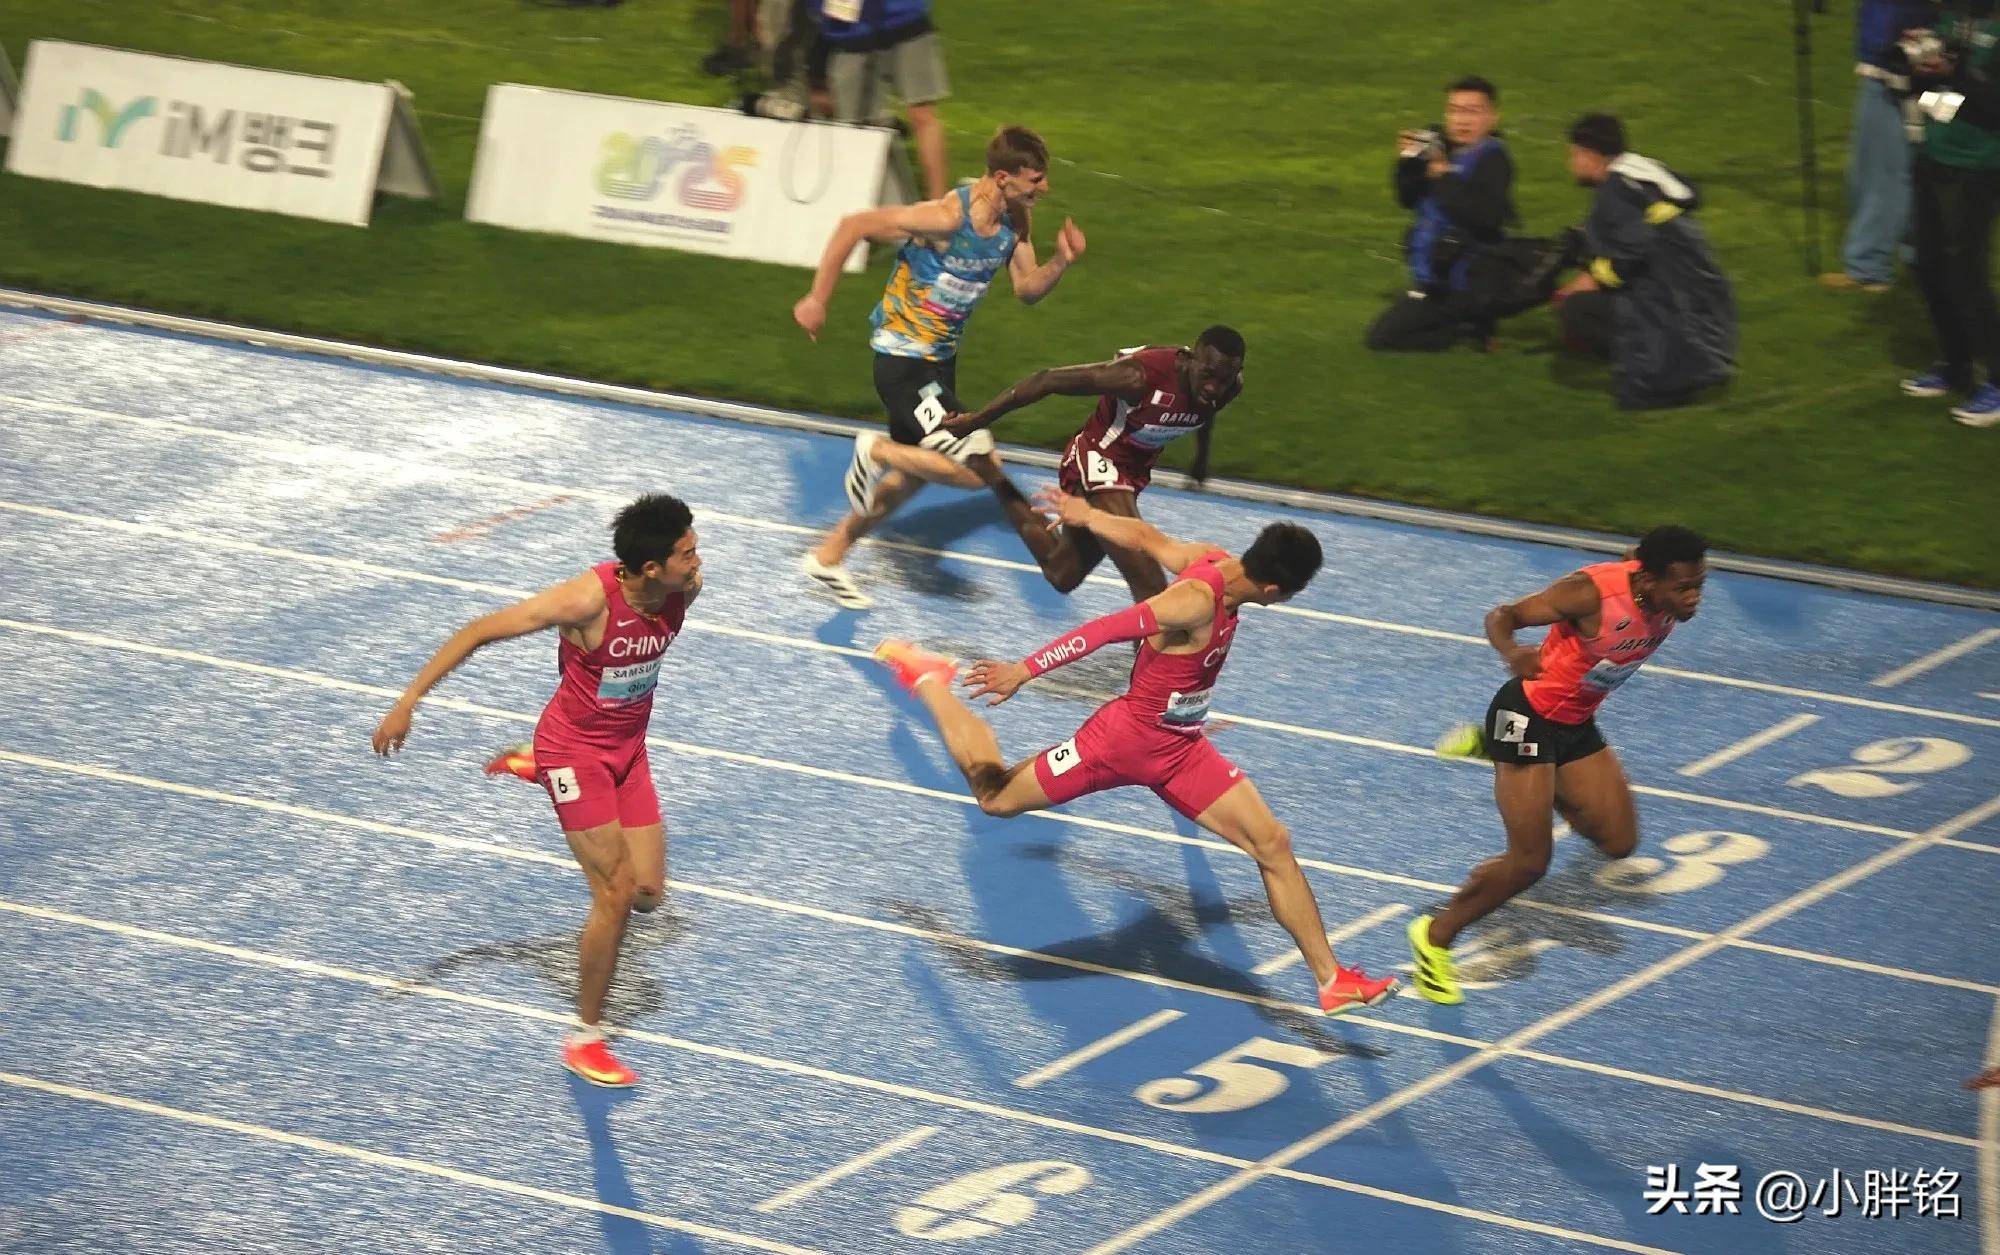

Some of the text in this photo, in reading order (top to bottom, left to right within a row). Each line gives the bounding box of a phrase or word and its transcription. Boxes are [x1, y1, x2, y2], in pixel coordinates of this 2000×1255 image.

[923, 407, 936, 421] 2
[1159, 411, 1199, 425] QATAR
[1097, 458, 1108, 473] 3
[1034, 635, 1087, 669] CHINA
[1504, 720, 1516, 736] 4
[1055, 748, 1070, 762] 5
[1786, 736, 1974, 798] 2
[558, 776, 568, 794] 6
[1595, 830, 1773, 895] 3
[1132, 1036, 1346, 1114] 5
[892, 1160, 1095, 1241] 6
